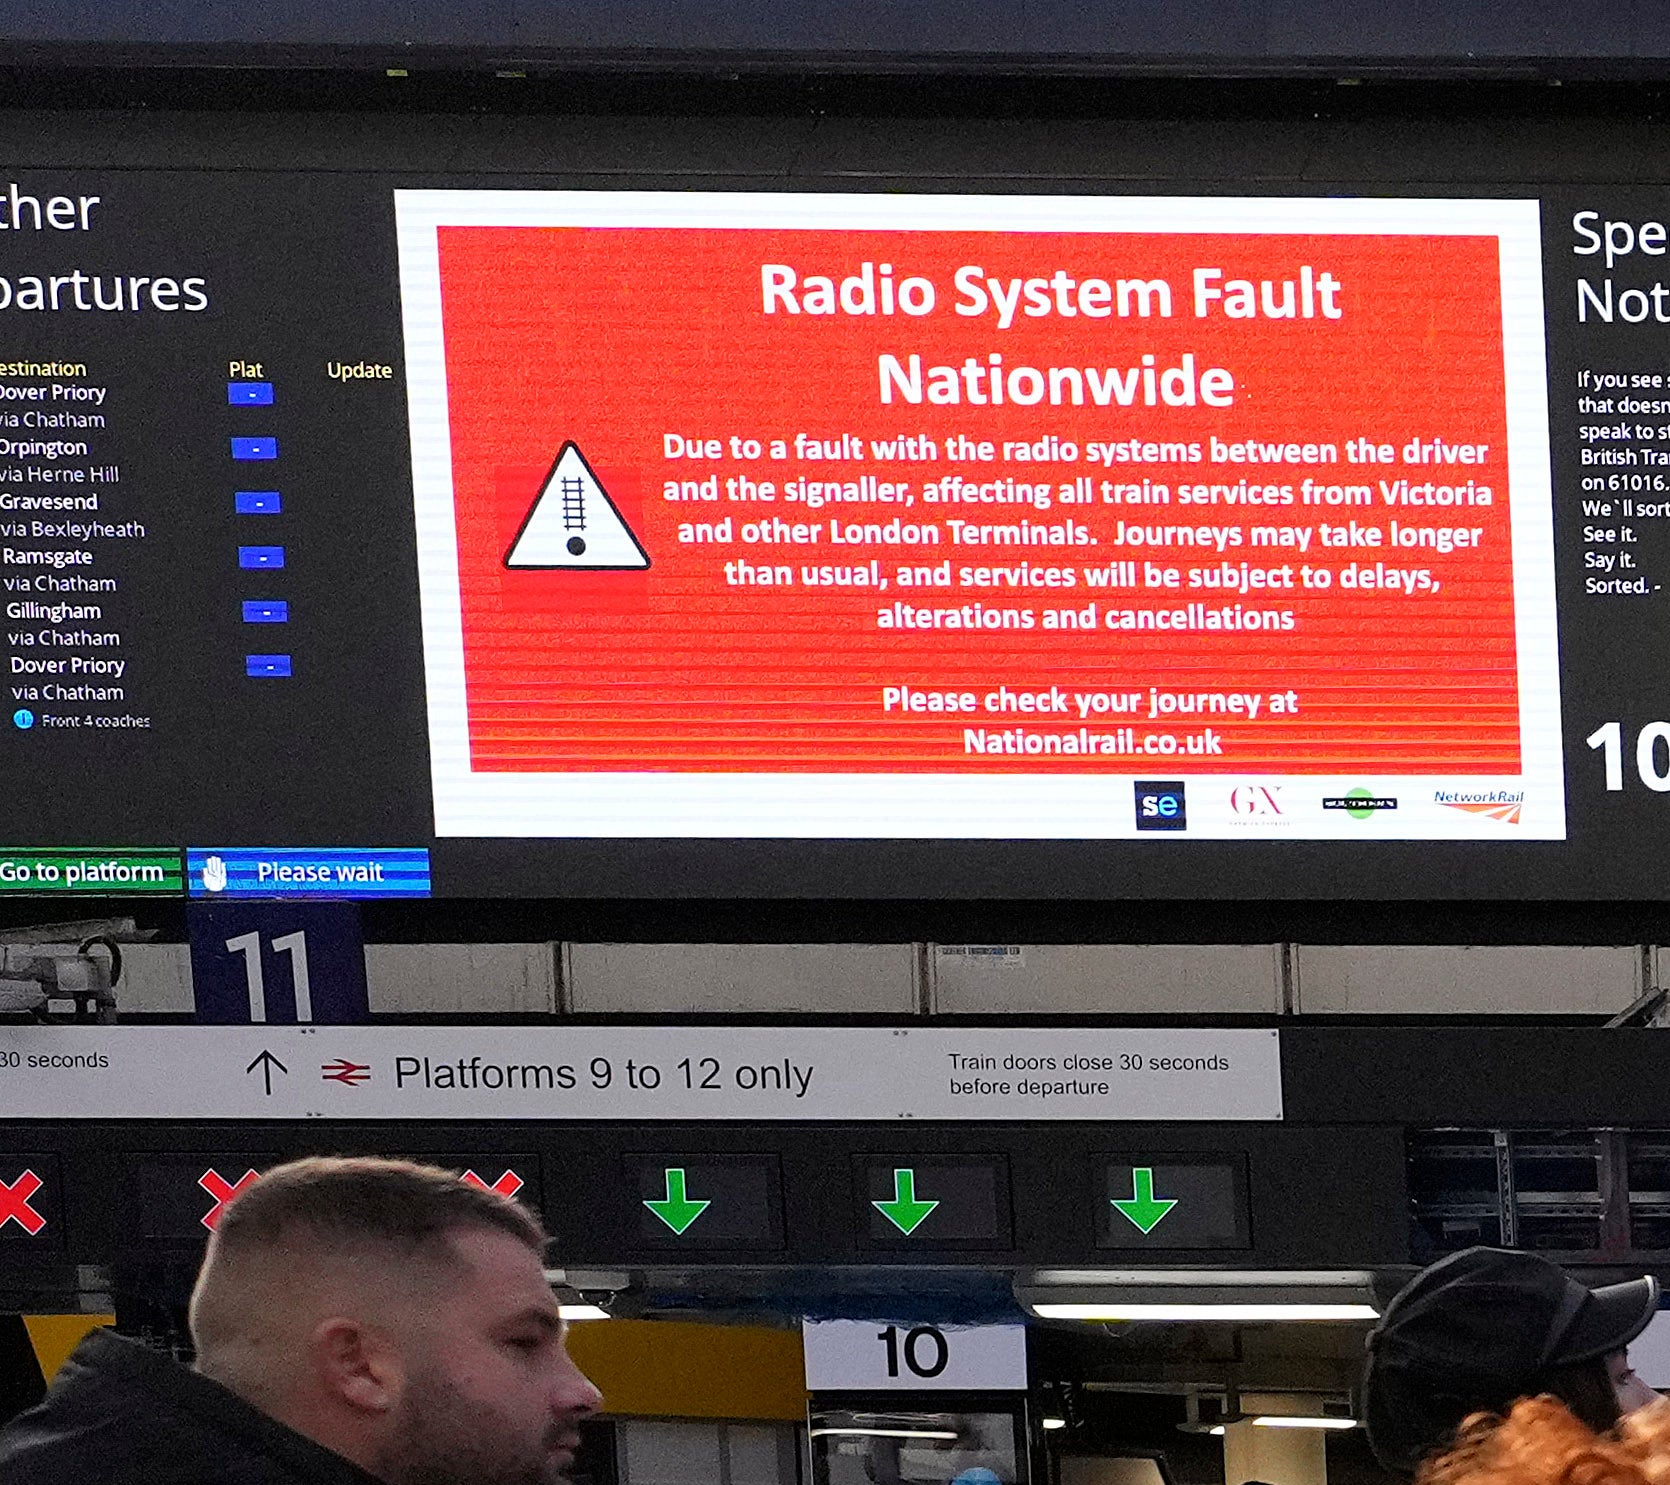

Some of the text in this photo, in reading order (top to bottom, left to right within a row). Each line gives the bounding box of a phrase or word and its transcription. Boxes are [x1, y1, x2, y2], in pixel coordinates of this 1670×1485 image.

[761, 261, 1343, 329] Radio System Fault
[229, 360, 264, 378] Plat
[327, 360, 393, 383] Update
[878, 353, 1234, 407] Nationwide
[3, 547, 93, 569] Ramsgate
[6, 601, 102, 624] Gillingham
[877, 601, 1296, 631] alterations and cancellations
[883, 685, 1299, 719] Please check your journey at
[963, 727, 1223, 755] Nationalrail.co.uk
[257, 861, 385, 882] Please wait
[225, 930, 313, 1023] 11
[947, 1053, 1230, 1071] Train doors close 30 seconds
[395, 1056, 814, 1098] Platforms 9 to 12 only
[877, 1321, 954, 1379] 10
